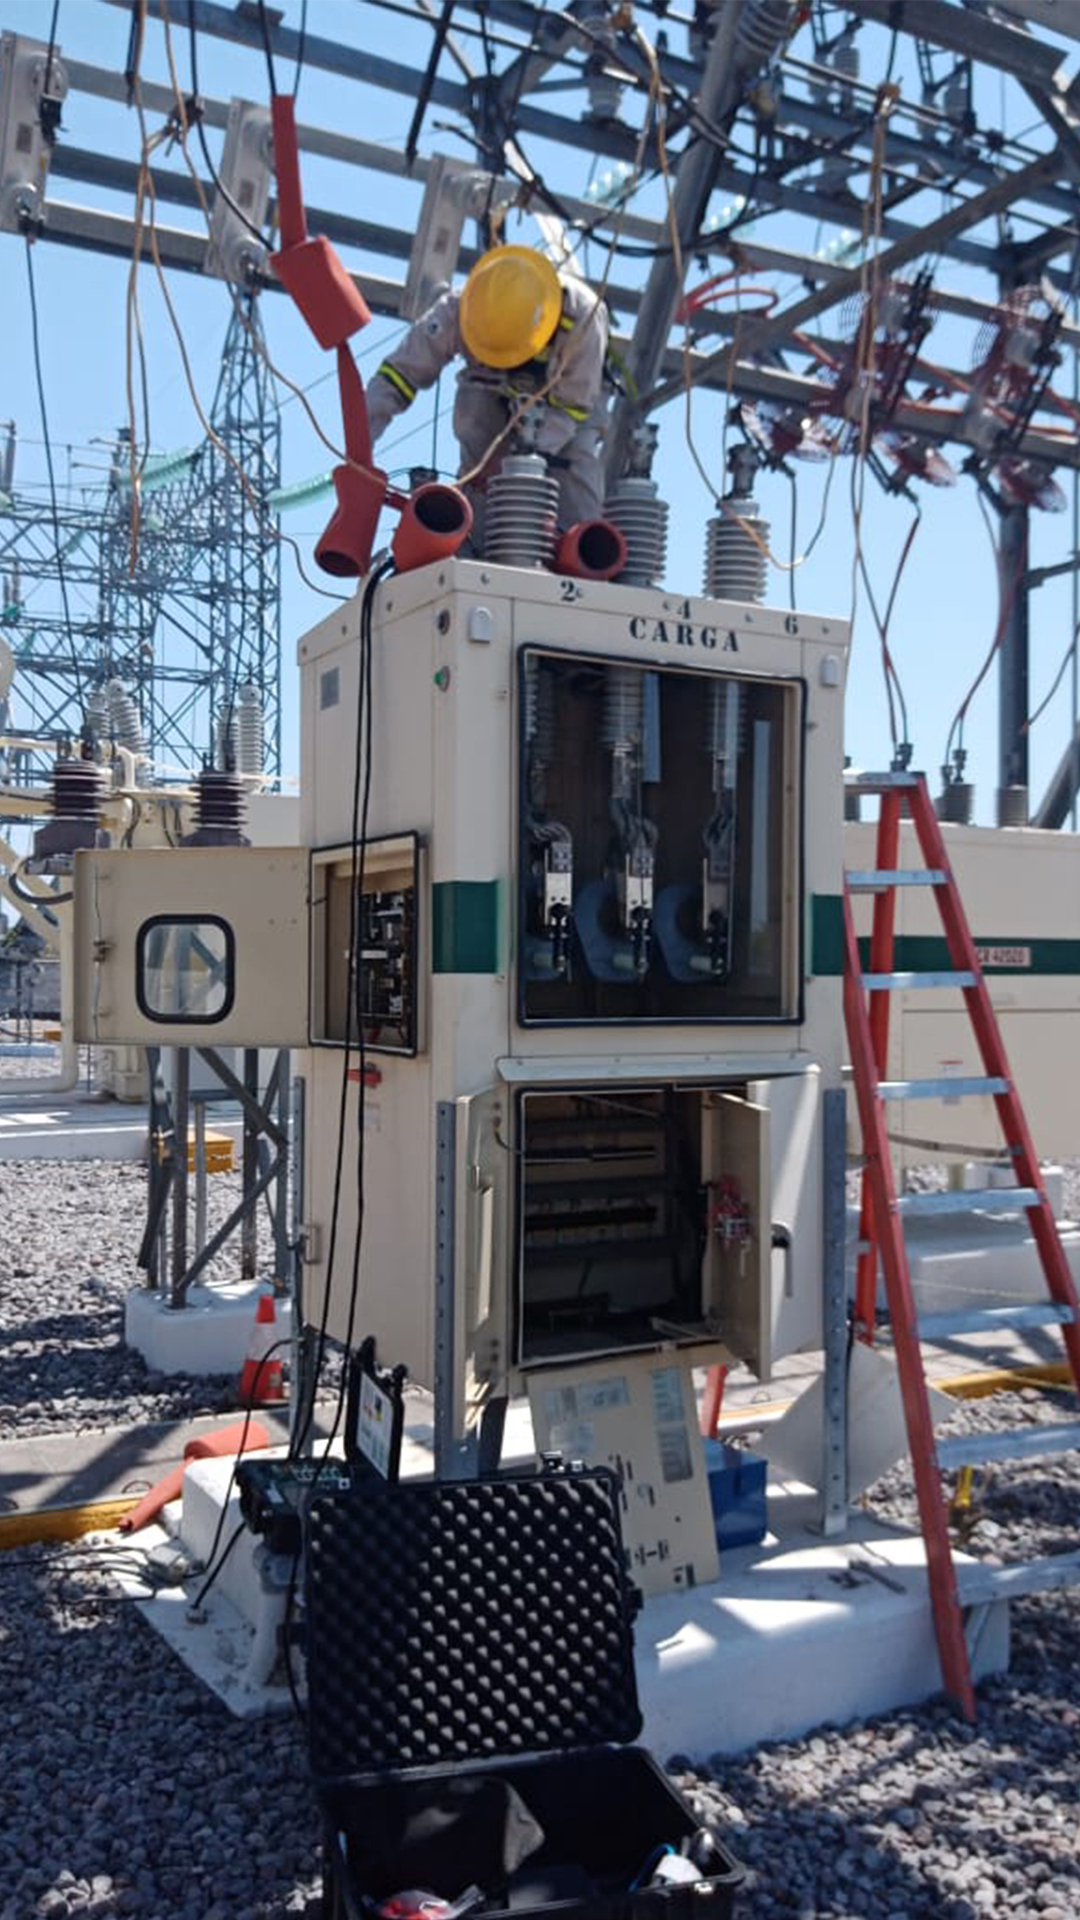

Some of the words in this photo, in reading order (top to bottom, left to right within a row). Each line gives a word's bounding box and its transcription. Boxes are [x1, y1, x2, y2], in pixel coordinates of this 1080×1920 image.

[561, 580, 576, 602] 2
[676, 599, 691, 620] 4
[784, 615, 799, 635] 6
[629, 615, 740, 653] CARGA
